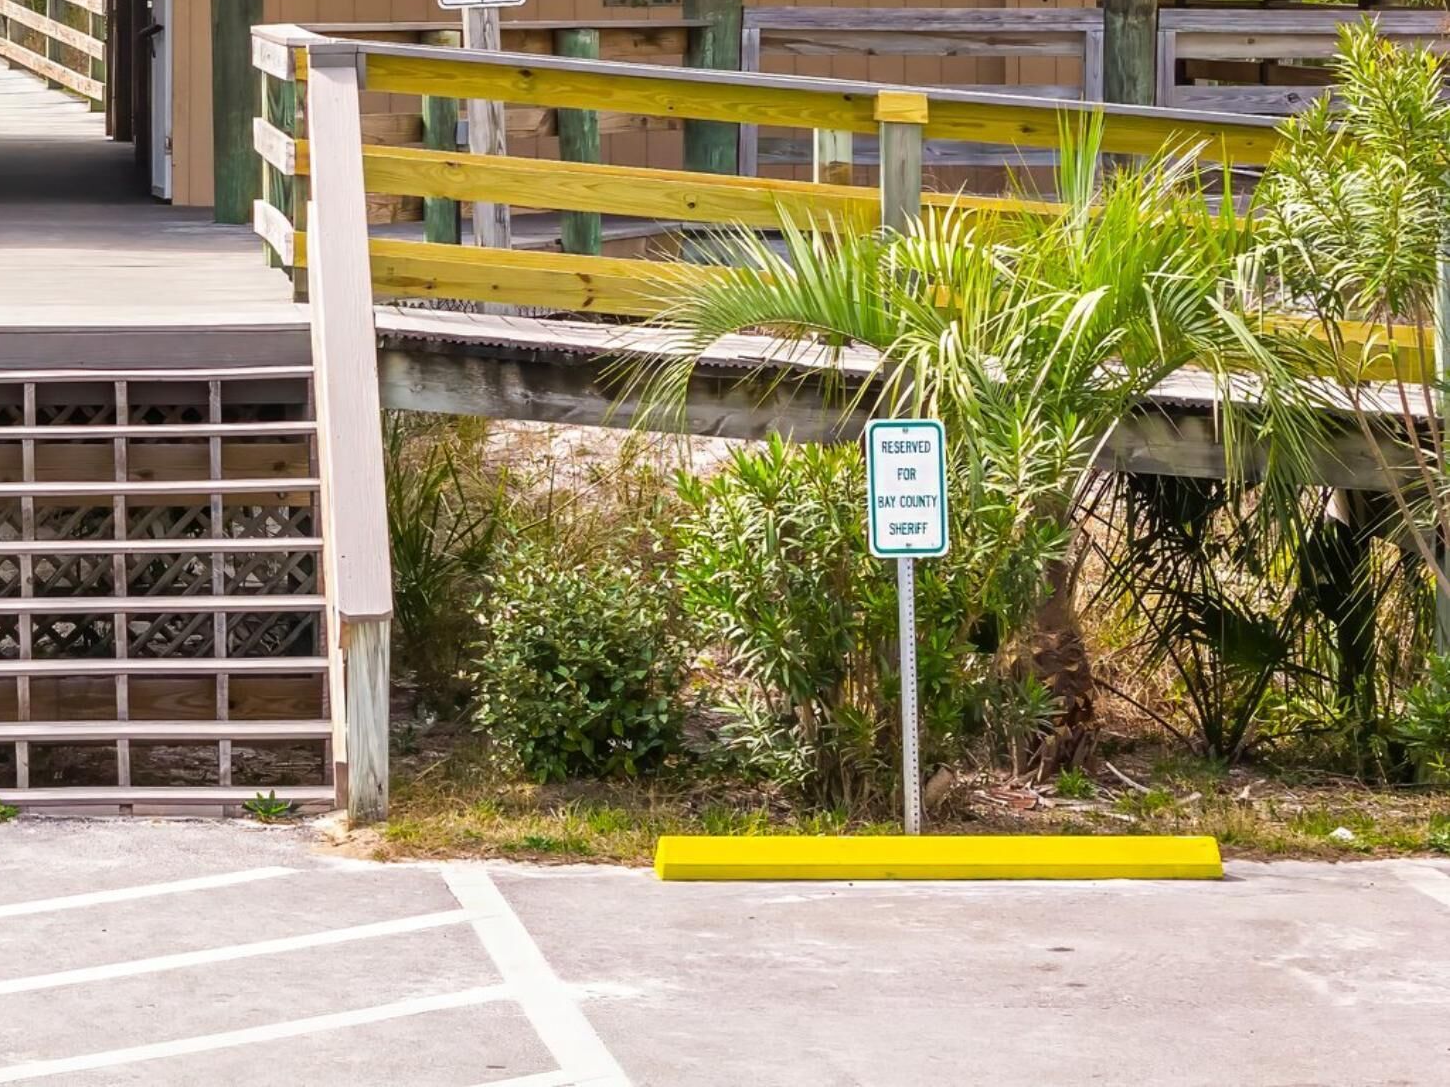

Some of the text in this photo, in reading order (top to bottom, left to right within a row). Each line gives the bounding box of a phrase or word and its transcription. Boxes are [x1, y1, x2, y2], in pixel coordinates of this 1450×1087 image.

[881, 441, 931, 454] RESERVED
[897, 468, 917, 481] FOR
[878, 495, 938, 509] BAY COUNTY
[888, 522, 929, 535] SHERIFF
